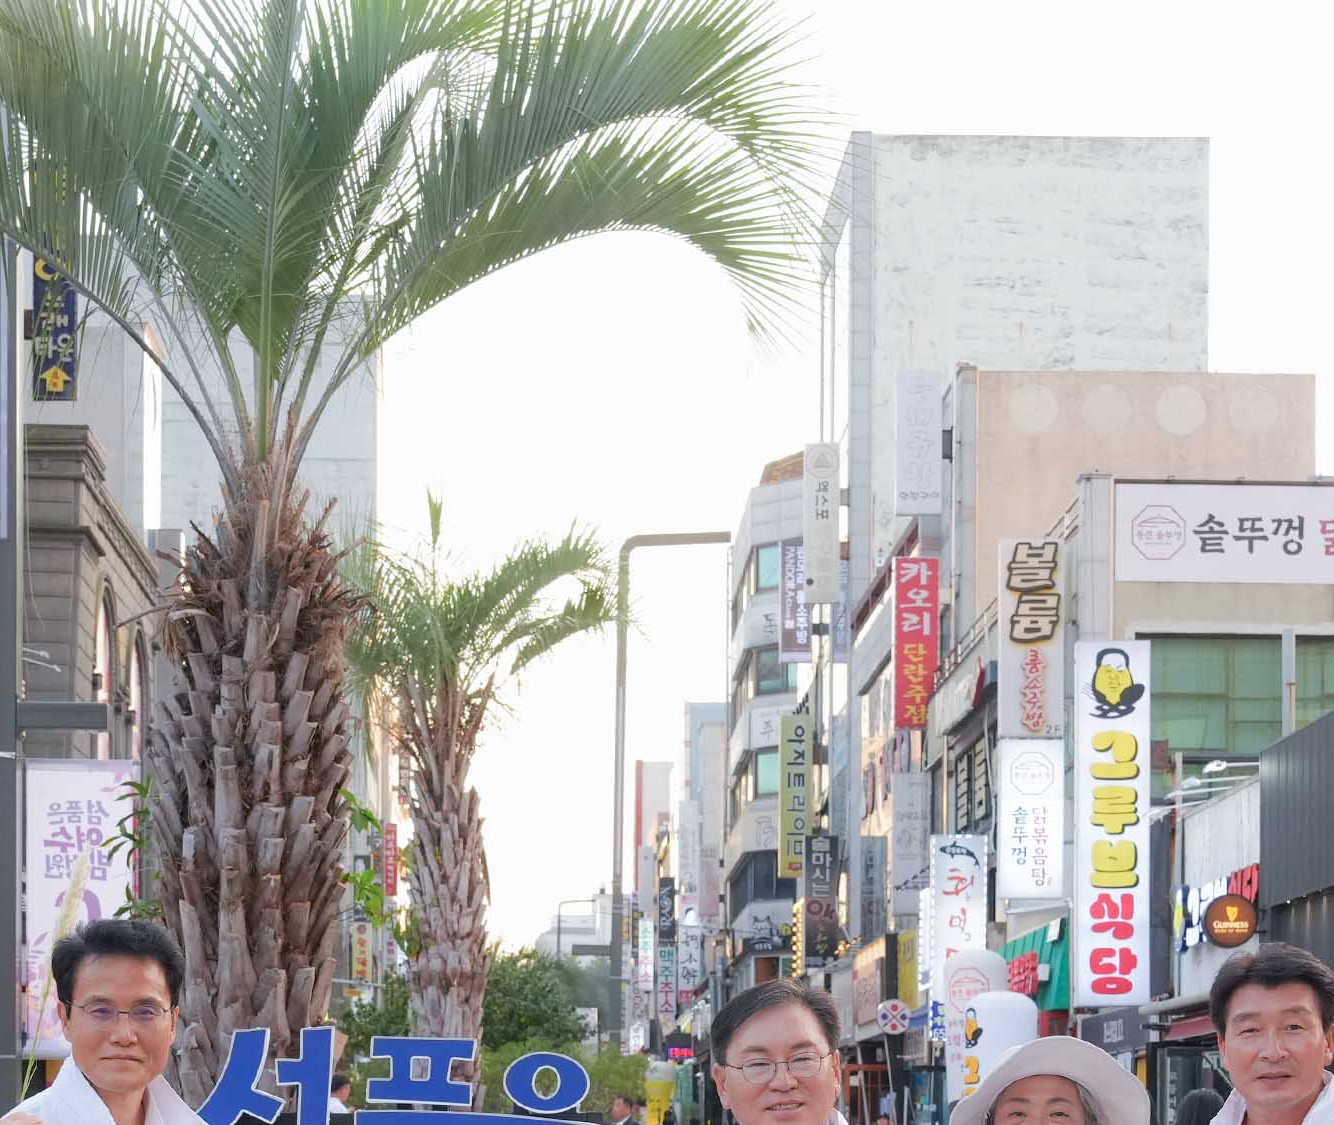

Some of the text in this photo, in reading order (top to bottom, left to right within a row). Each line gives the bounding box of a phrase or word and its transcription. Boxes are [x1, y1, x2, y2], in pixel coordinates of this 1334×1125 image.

[1193, 512, 1306, 556] 솥뚜껑
[899, 562, 932, 637] 카오리
[1006, 541, 1061, 644] 볼륨
[902, 642, 928, 724] 단란주점
[1011, 806, 1028, 866] 솥뚜껑
[1032, 806, 1049, 887] 닭볶음탕
